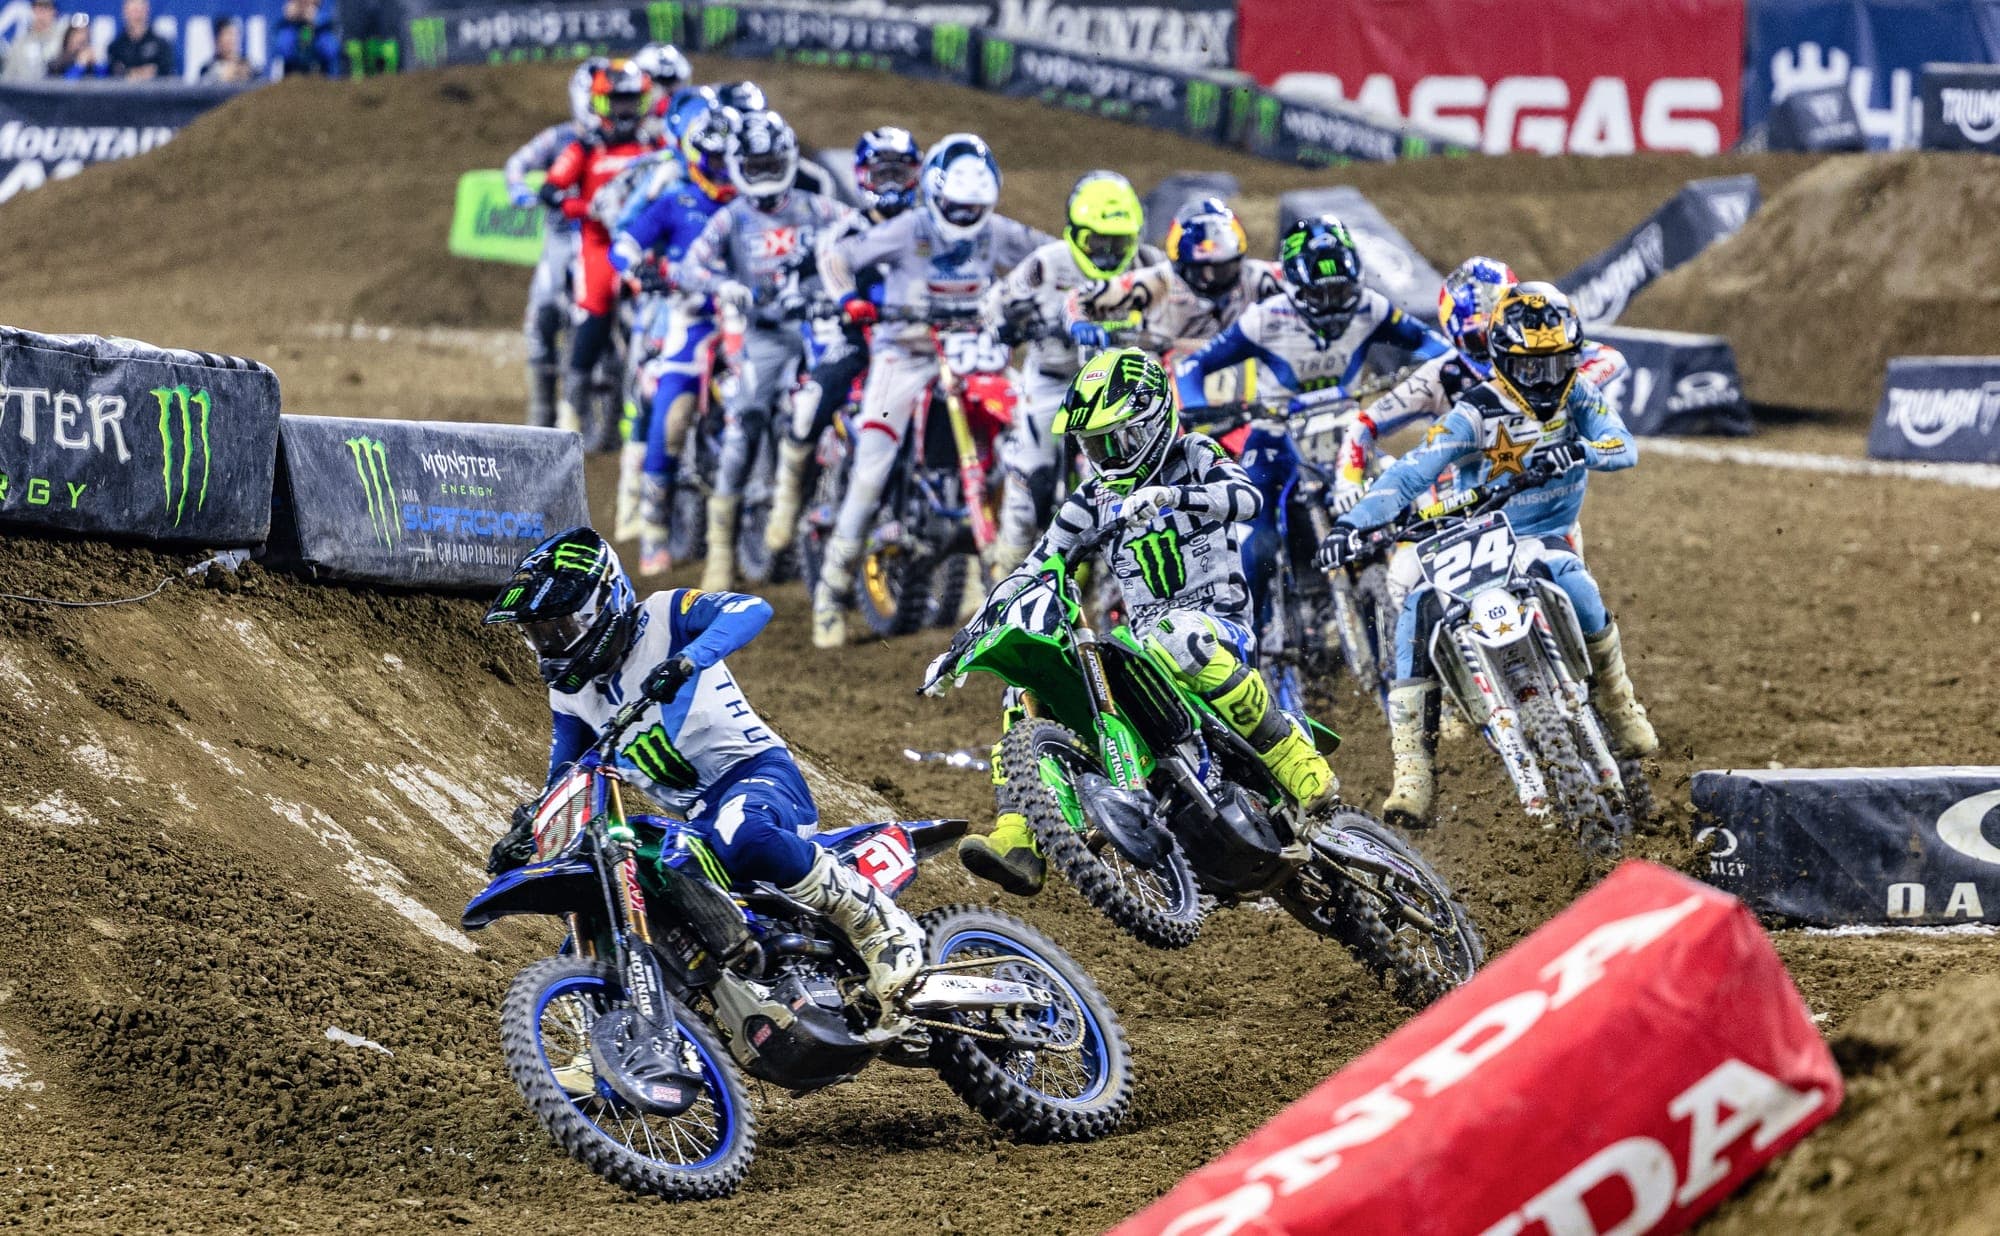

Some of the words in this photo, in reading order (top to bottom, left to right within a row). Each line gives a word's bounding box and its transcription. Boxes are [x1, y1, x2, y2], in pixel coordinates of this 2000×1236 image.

[1085, 371, 1104, 380] BELL
[0, 384, 131, 464] TER
[420, 449, 501, 481] MONSTER
[441, 483, 494, 497] ENERGY
[402, 504, 545, 539] SUPERCROSS
[437, 542, 518, 566] CHAMPIONSHIP
[1433, 526, 1515, 592] 24
[1105, 736, 1129, 791] DUNLOP
[1887, 882, 1984, 918] OA
[629, 950, 655, 1017] DUNLOP
[1478, 1058, 1824, 1236] DA
